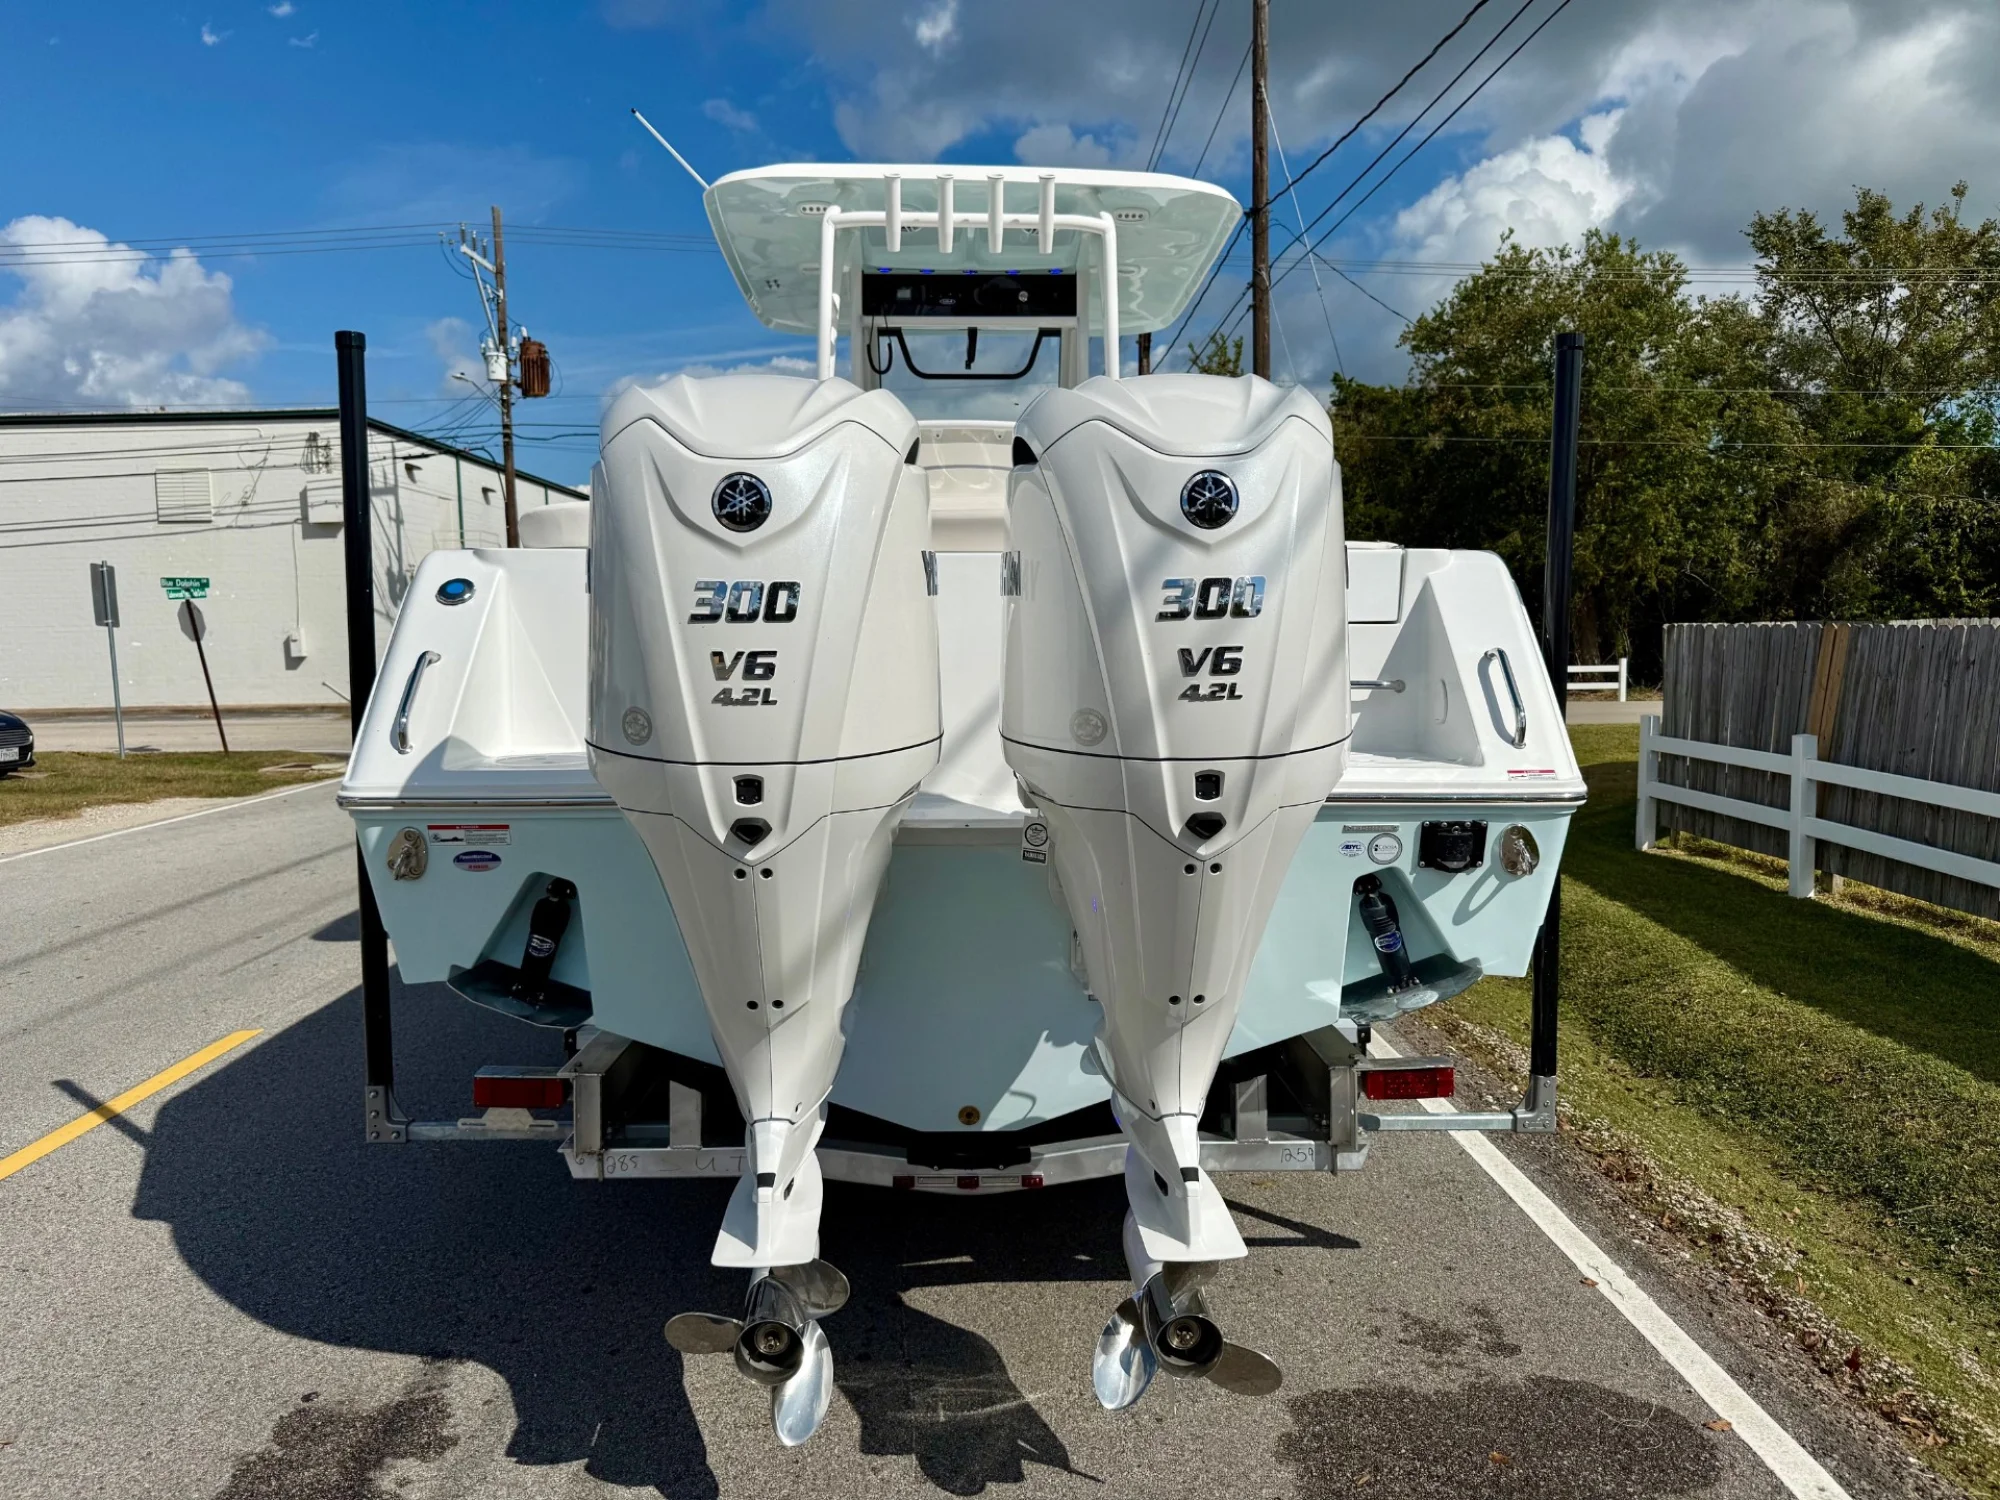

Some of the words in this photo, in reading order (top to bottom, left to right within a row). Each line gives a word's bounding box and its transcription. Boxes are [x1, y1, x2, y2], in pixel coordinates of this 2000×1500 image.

[161, 578, 174, 587] Blue
[175, 578, 201, 588] Dolphin
[687, 580, 801, 624] 300
[1155, 576, 1266, 622] 300
[710, 650, 778, 681] V6
[1177, 646, 1244, 677] V6
[711, 687, 778, 706] 4.2L
[1178, 682, 1243, 702] 4.2L
